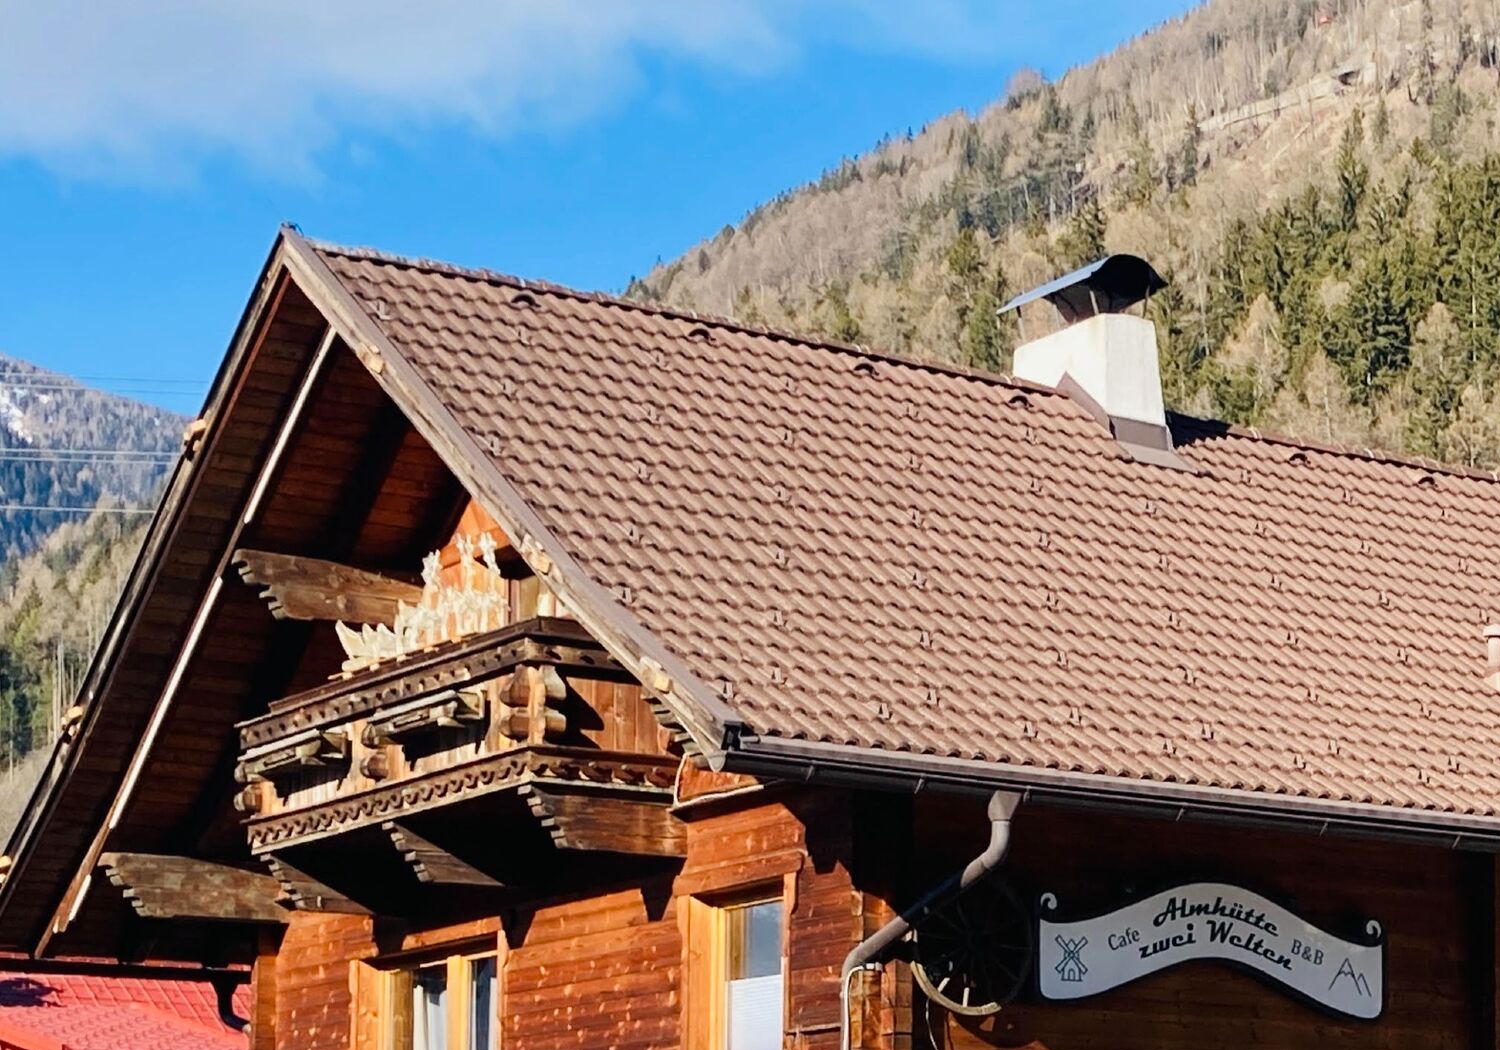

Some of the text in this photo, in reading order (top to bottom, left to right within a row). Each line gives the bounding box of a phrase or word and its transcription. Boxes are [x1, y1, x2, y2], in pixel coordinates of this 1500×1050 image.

[1153, 896, 1279, 937] Almhütte
[1108, 927, 1140, 951] Cafe
[1139, 920, 1293, 971] zwei Welten
[1291, 938, 1324, 966] B&B
